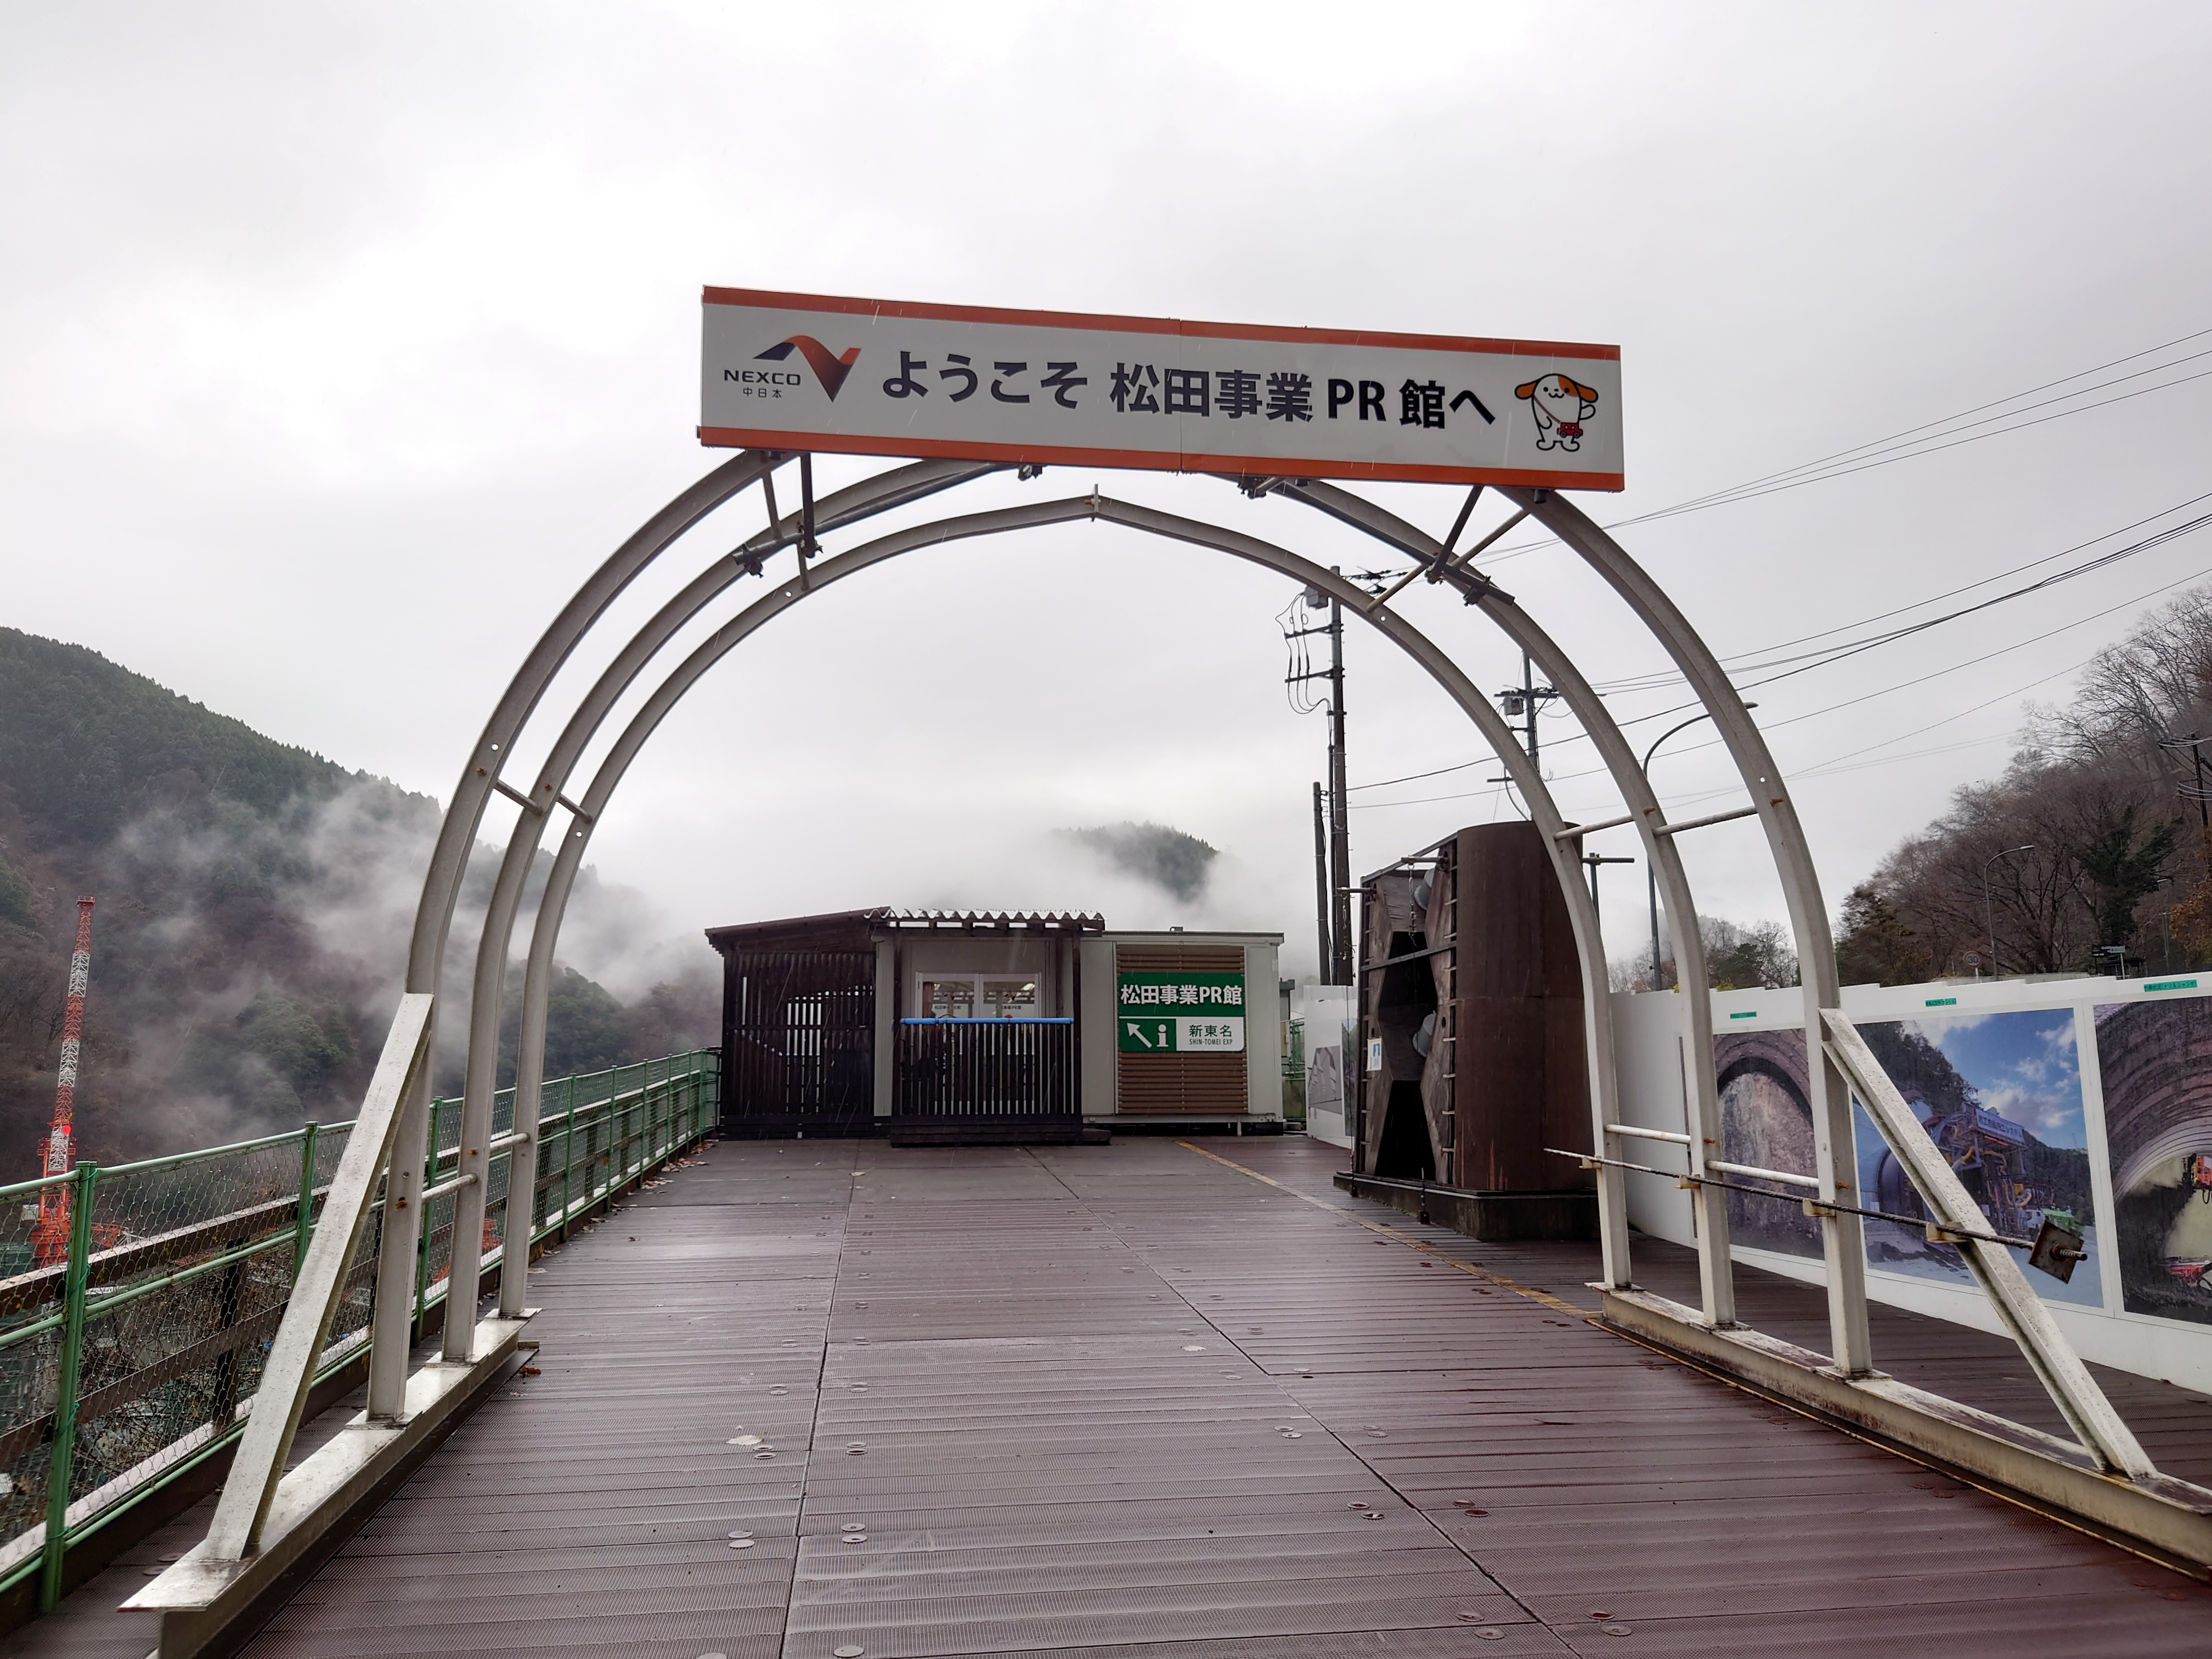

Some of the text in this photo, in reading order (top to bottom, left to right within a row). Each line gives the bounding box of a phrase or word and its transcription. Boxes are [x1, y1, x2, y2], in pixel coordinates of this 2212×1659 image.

[724, 369, 801, 386] NEXCO
[883, 351, 1087, 409] ようこそ
[743, 387, 782, 398] 中日本
[1968, 956, 1978, 964] 30
[1121, 984, 1242, 1005] 松田事業PR館
[1189, 1024, 1232, 1037] 新東名
